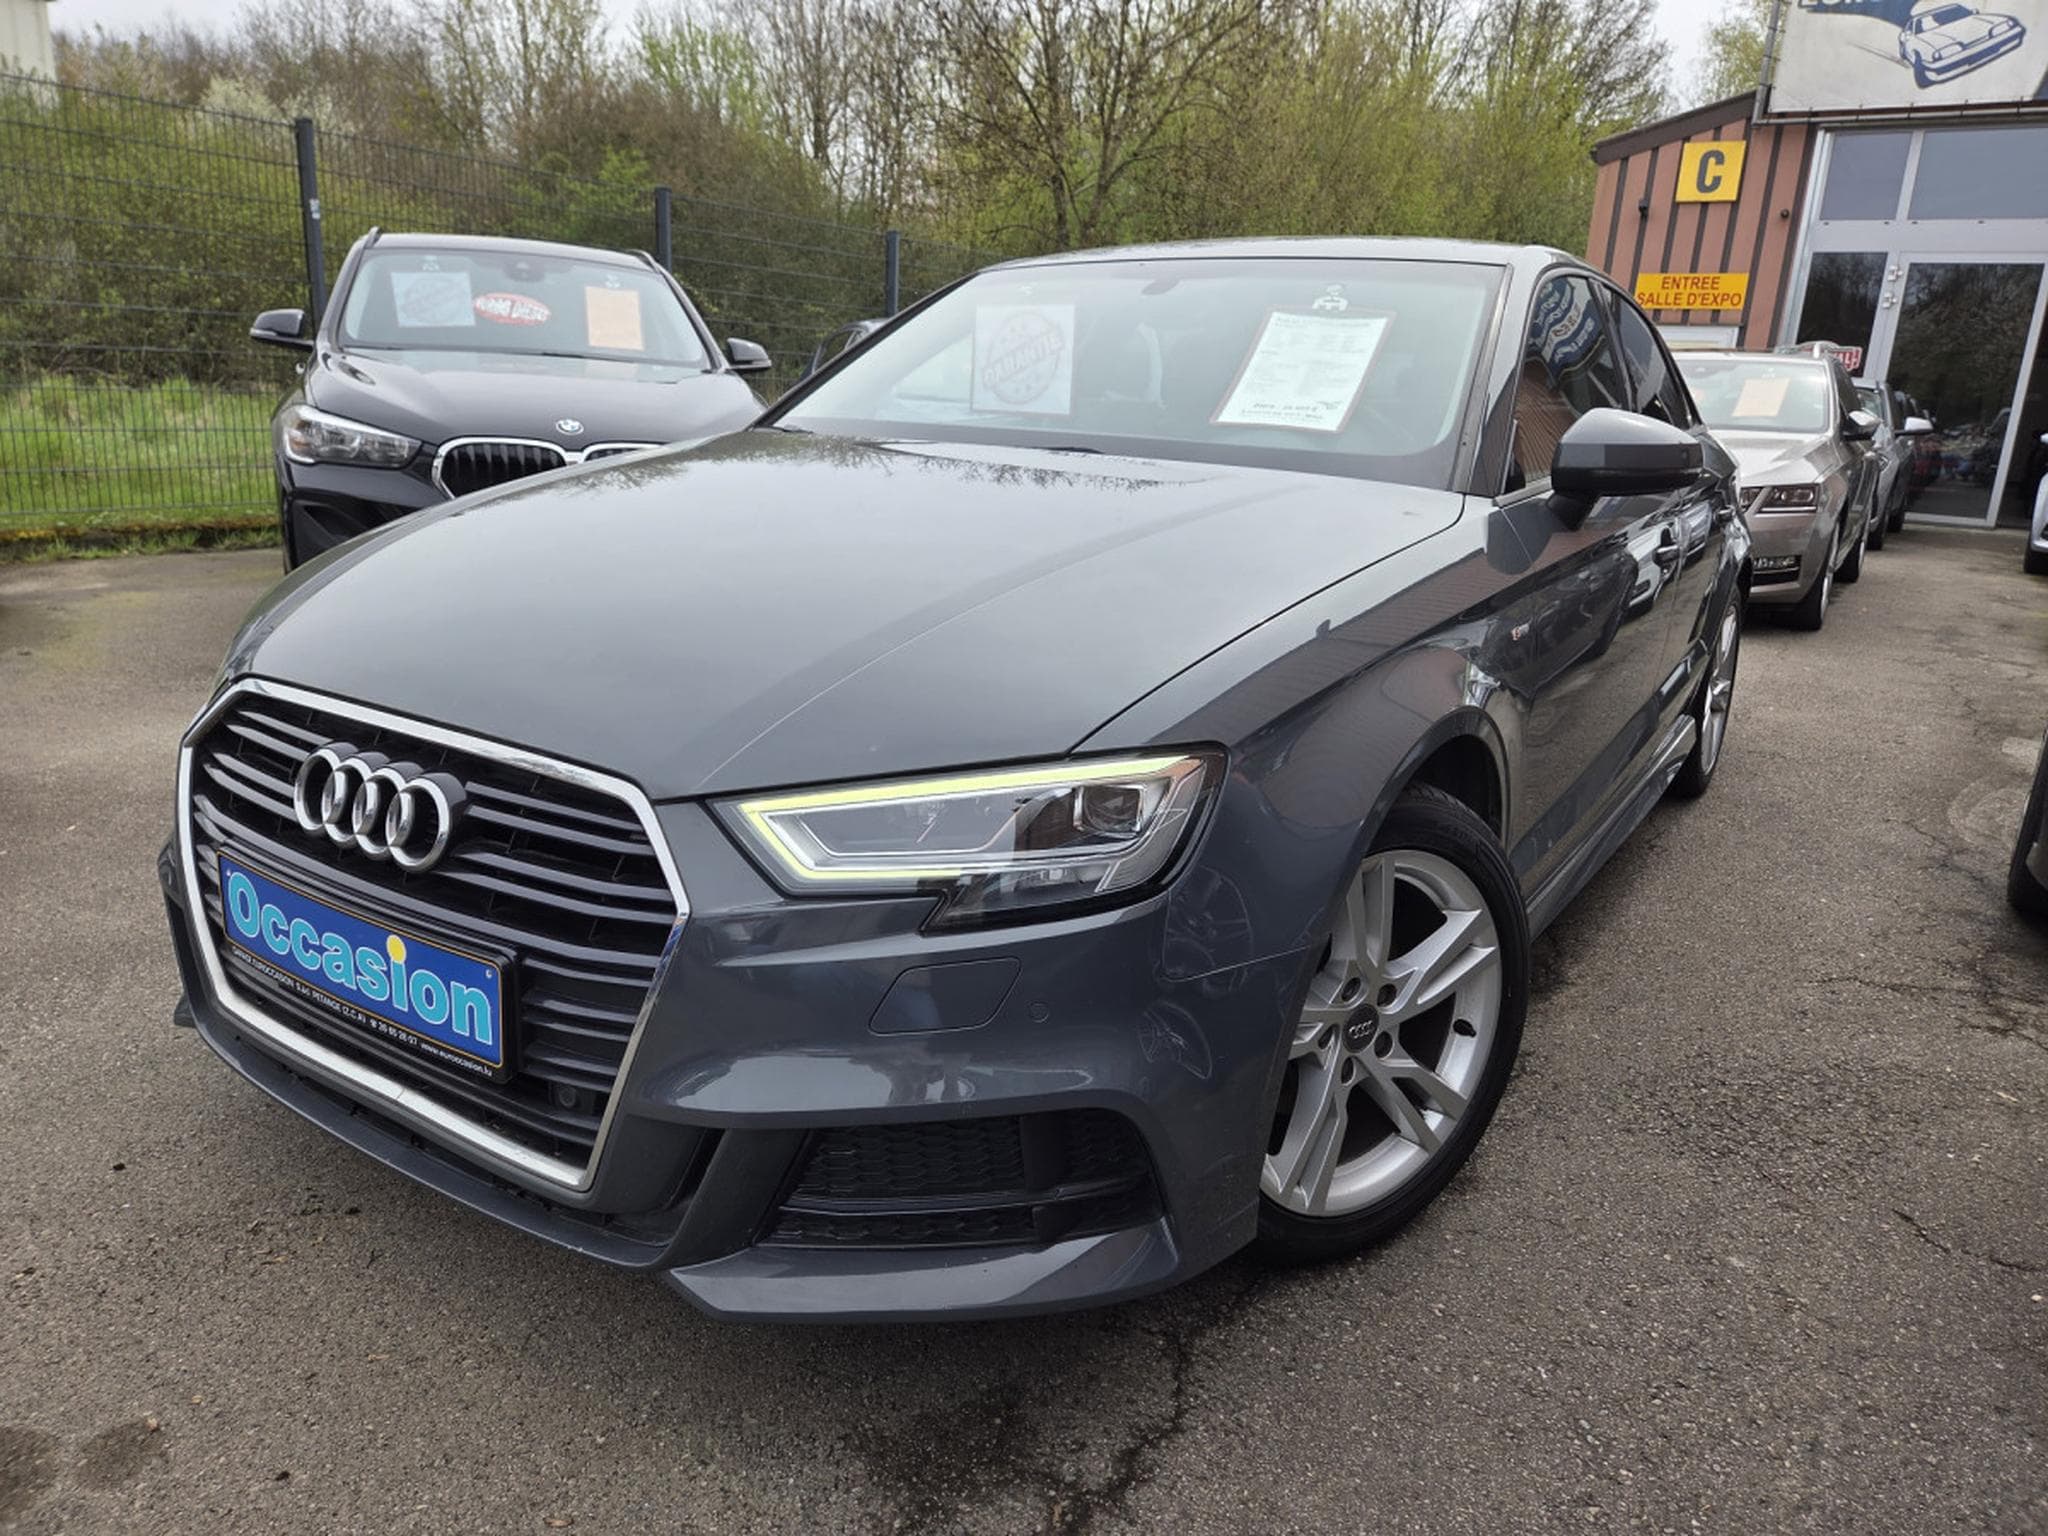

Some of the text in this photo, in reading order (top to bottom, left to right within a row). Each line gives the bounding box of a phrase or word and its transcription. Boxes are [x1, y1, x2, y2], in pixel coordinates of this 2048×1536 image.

[1696, 149, 1725, 194] C
[1661, 276, 1721, 291] ENTREE
[1637, 292, 1742, 307] SALLE D'EXPO
[227, 871, 493, 1046] Occasion
